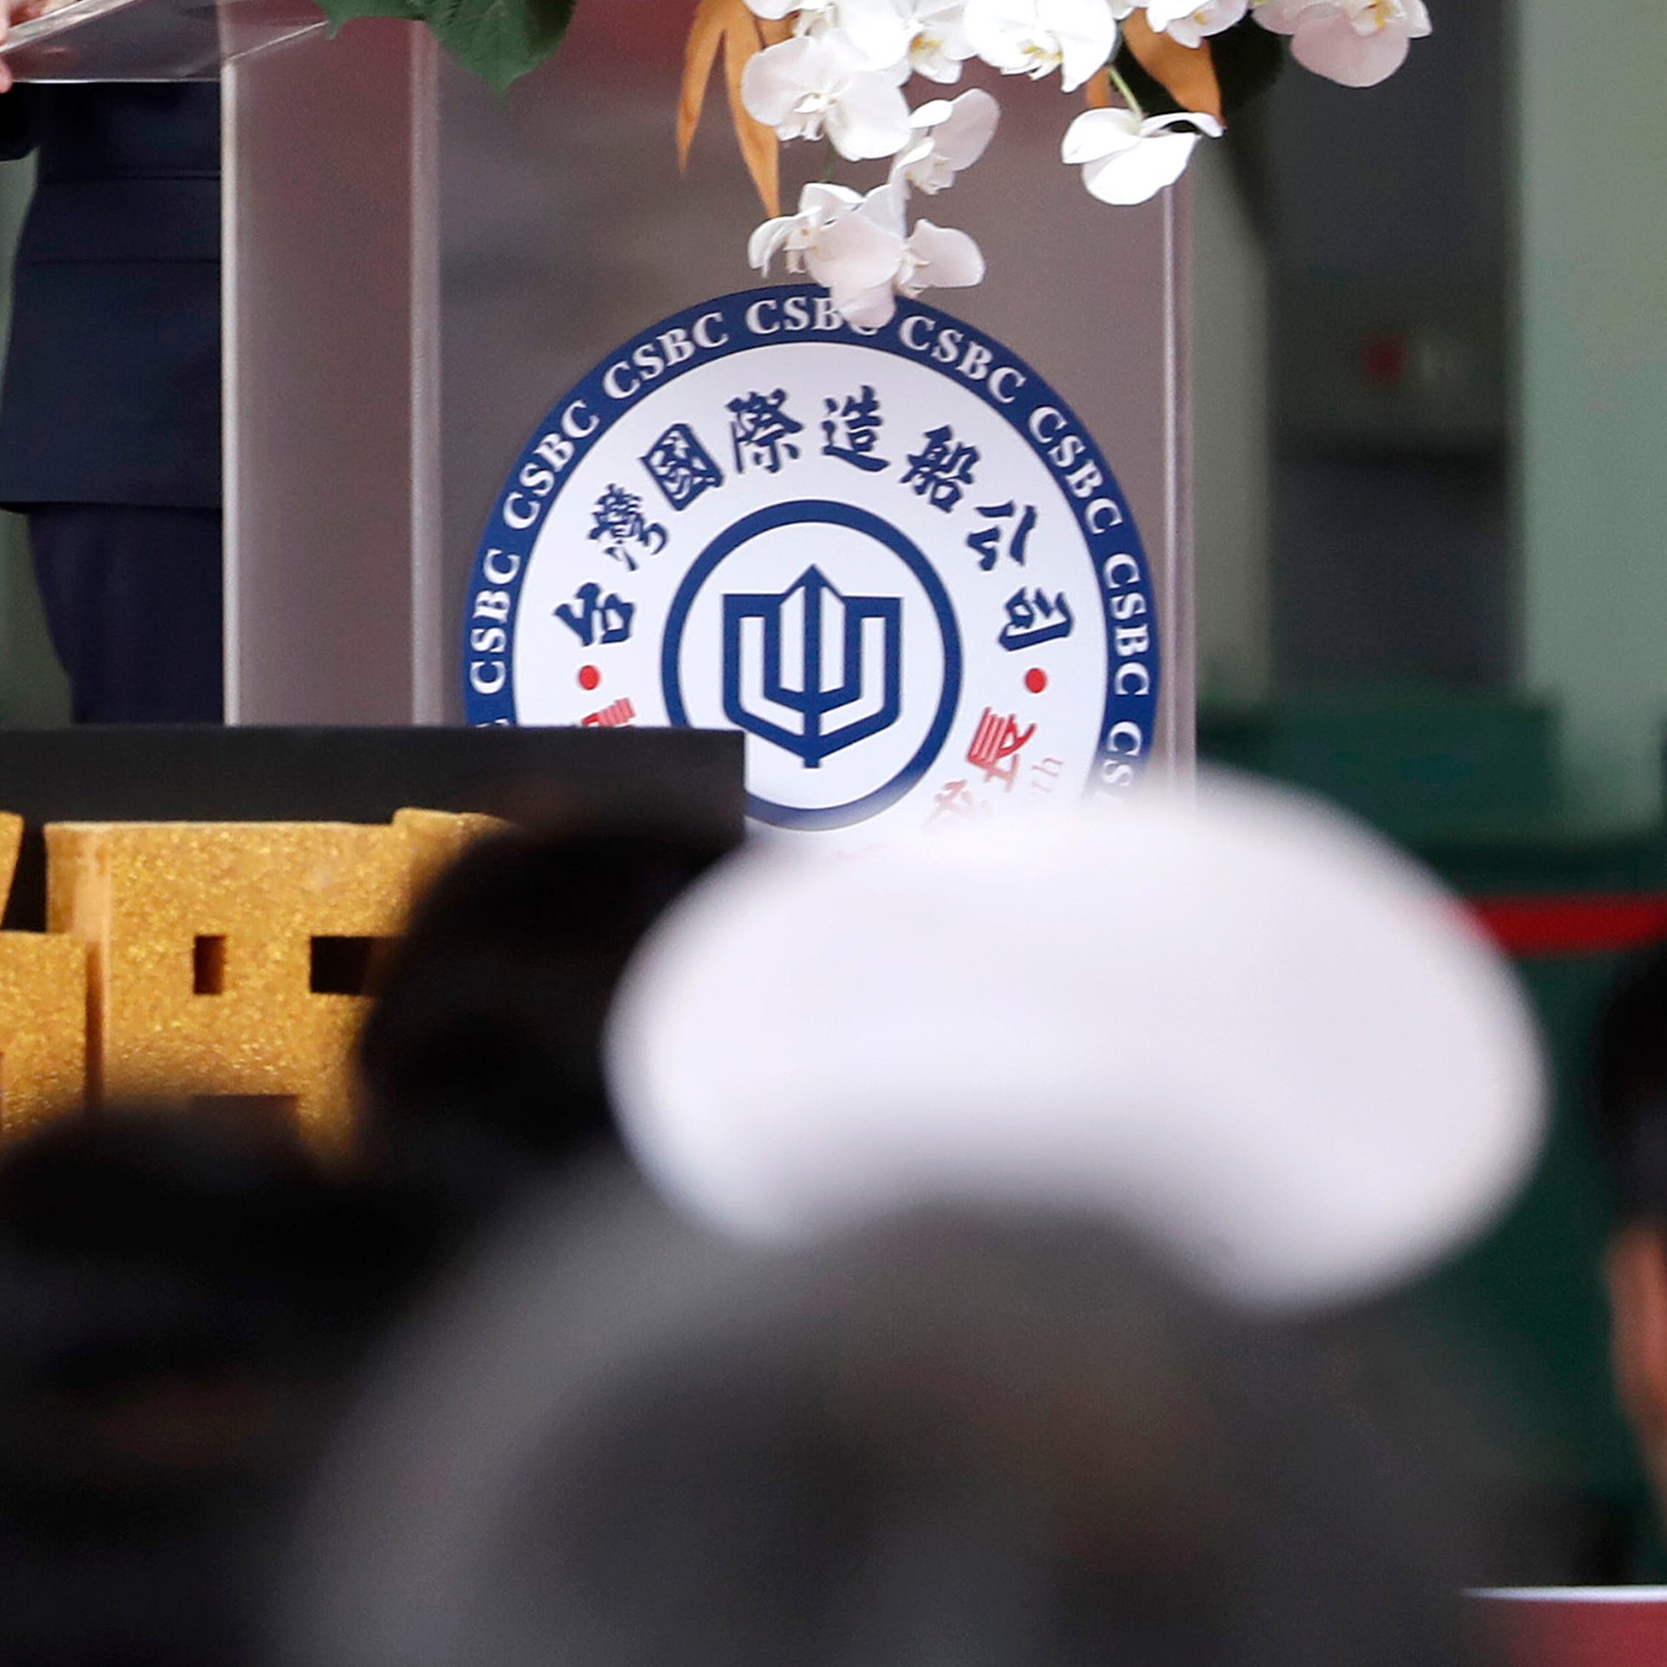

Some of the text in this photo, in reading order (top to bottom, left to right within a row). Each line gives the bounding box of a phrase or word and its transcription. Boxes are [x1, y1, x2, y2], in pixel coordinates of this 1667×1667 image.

[469, 296, 1151, 796] CSBC CSBC CSBC CSB CSBC CSBC CSBC CS
[554, 384, 1074, 652] 台灣國際造船公司
